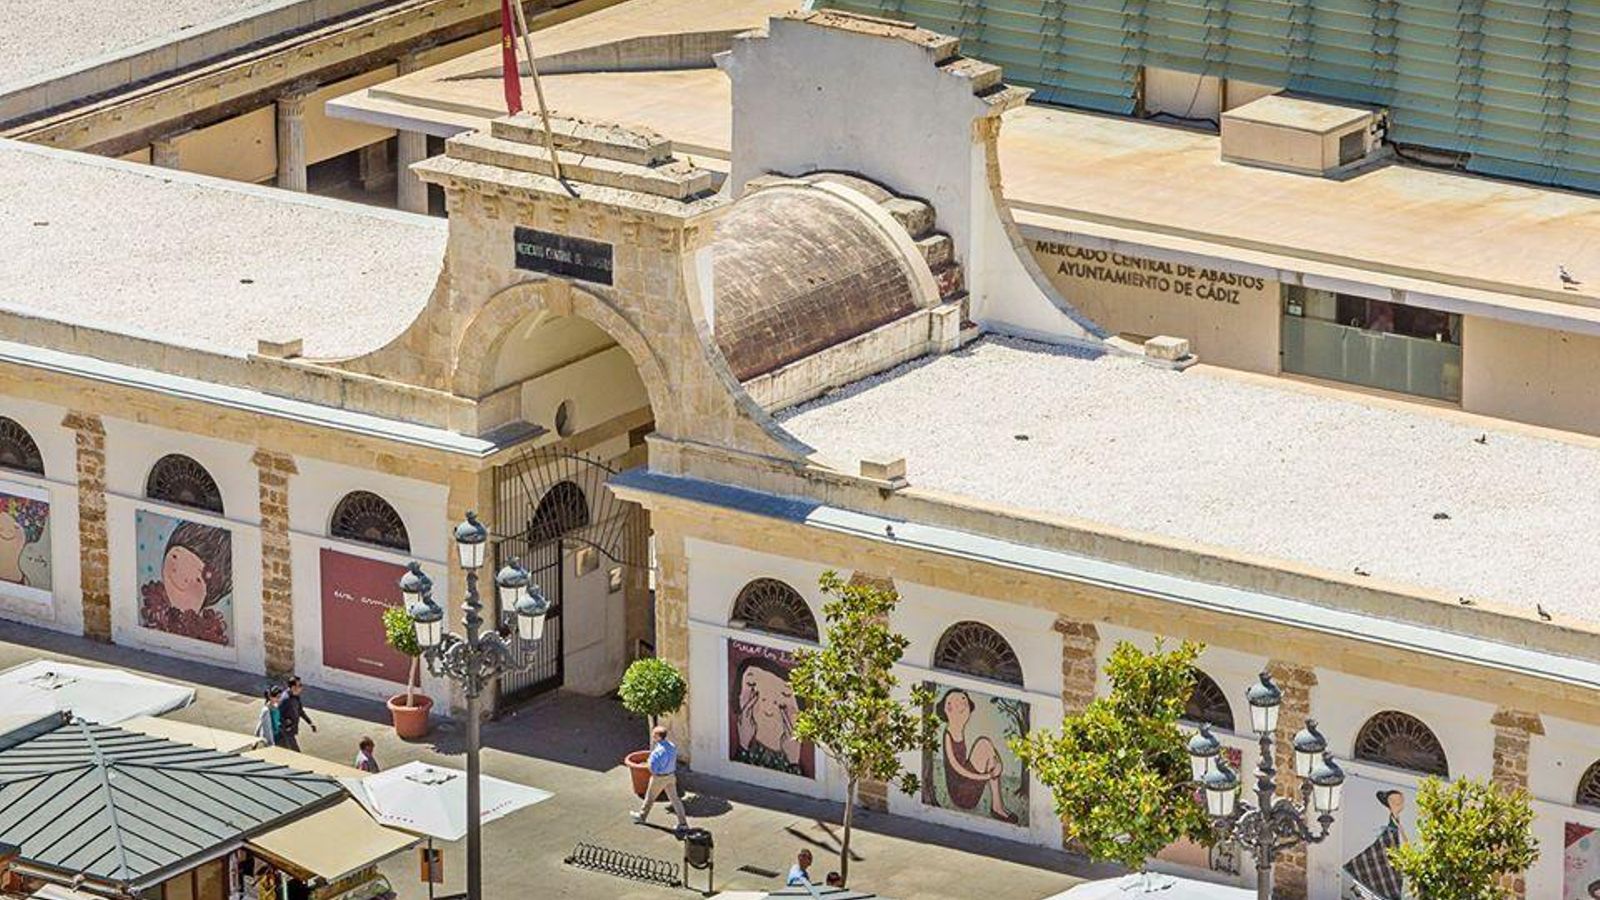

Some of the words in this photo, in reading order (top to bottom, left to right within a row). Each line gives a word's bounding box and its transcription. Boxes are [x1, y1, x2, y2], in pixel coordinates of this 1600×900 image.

[1035, 241, 1107, 263] MERCADO
[1112, 253, 1173, 275] CENTRAL
[1177, 264, 1196, 279] DE
[1199, 268, 1265, 291] ABASTOS
[1057, 261, 1170, 291] AYUNTAMIENTO
[1174, 280, 1193, 297] DE
[1195, 283, 1241, 305] CÁDIZ
